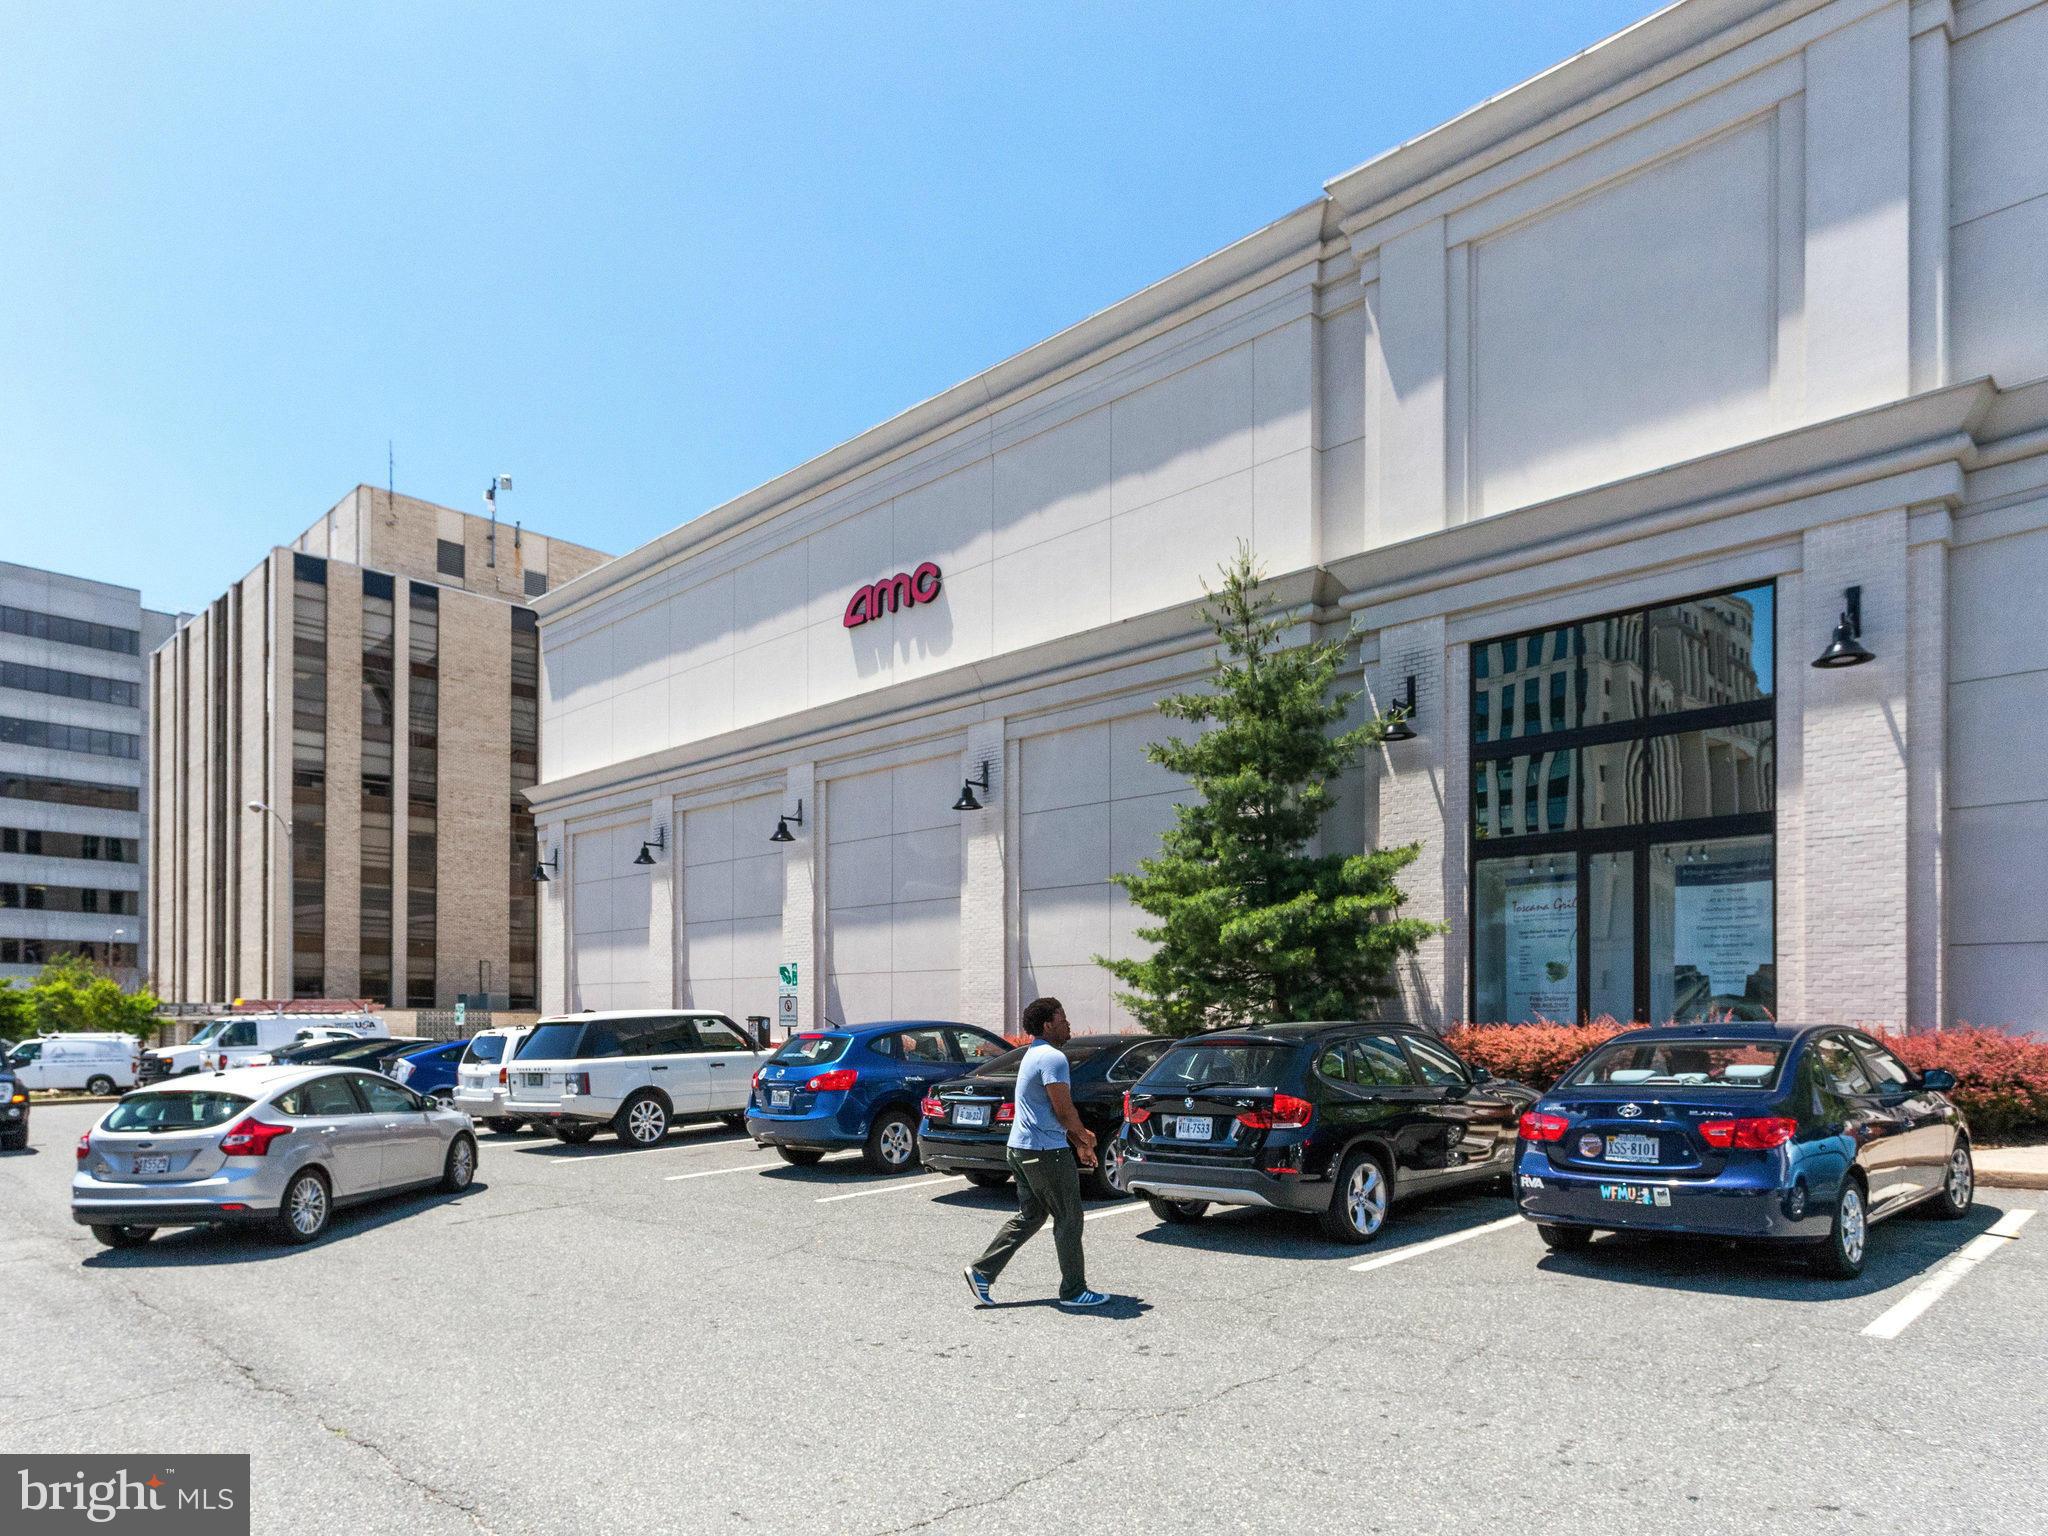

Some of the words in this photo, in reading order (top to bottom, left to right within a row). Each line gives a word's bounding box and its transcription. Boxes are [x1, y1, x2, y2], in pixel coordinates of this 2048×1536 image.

[1512, 900, 1550, 913] Toscana
[1689, 1110, 1734, 1118] ELANTRA
[1607, 1141, 1657, 1157] XSS-8101
[1520, 1177, 1545, 1189] RVA
[1600, 1184, 1636, 1202] WFMU
